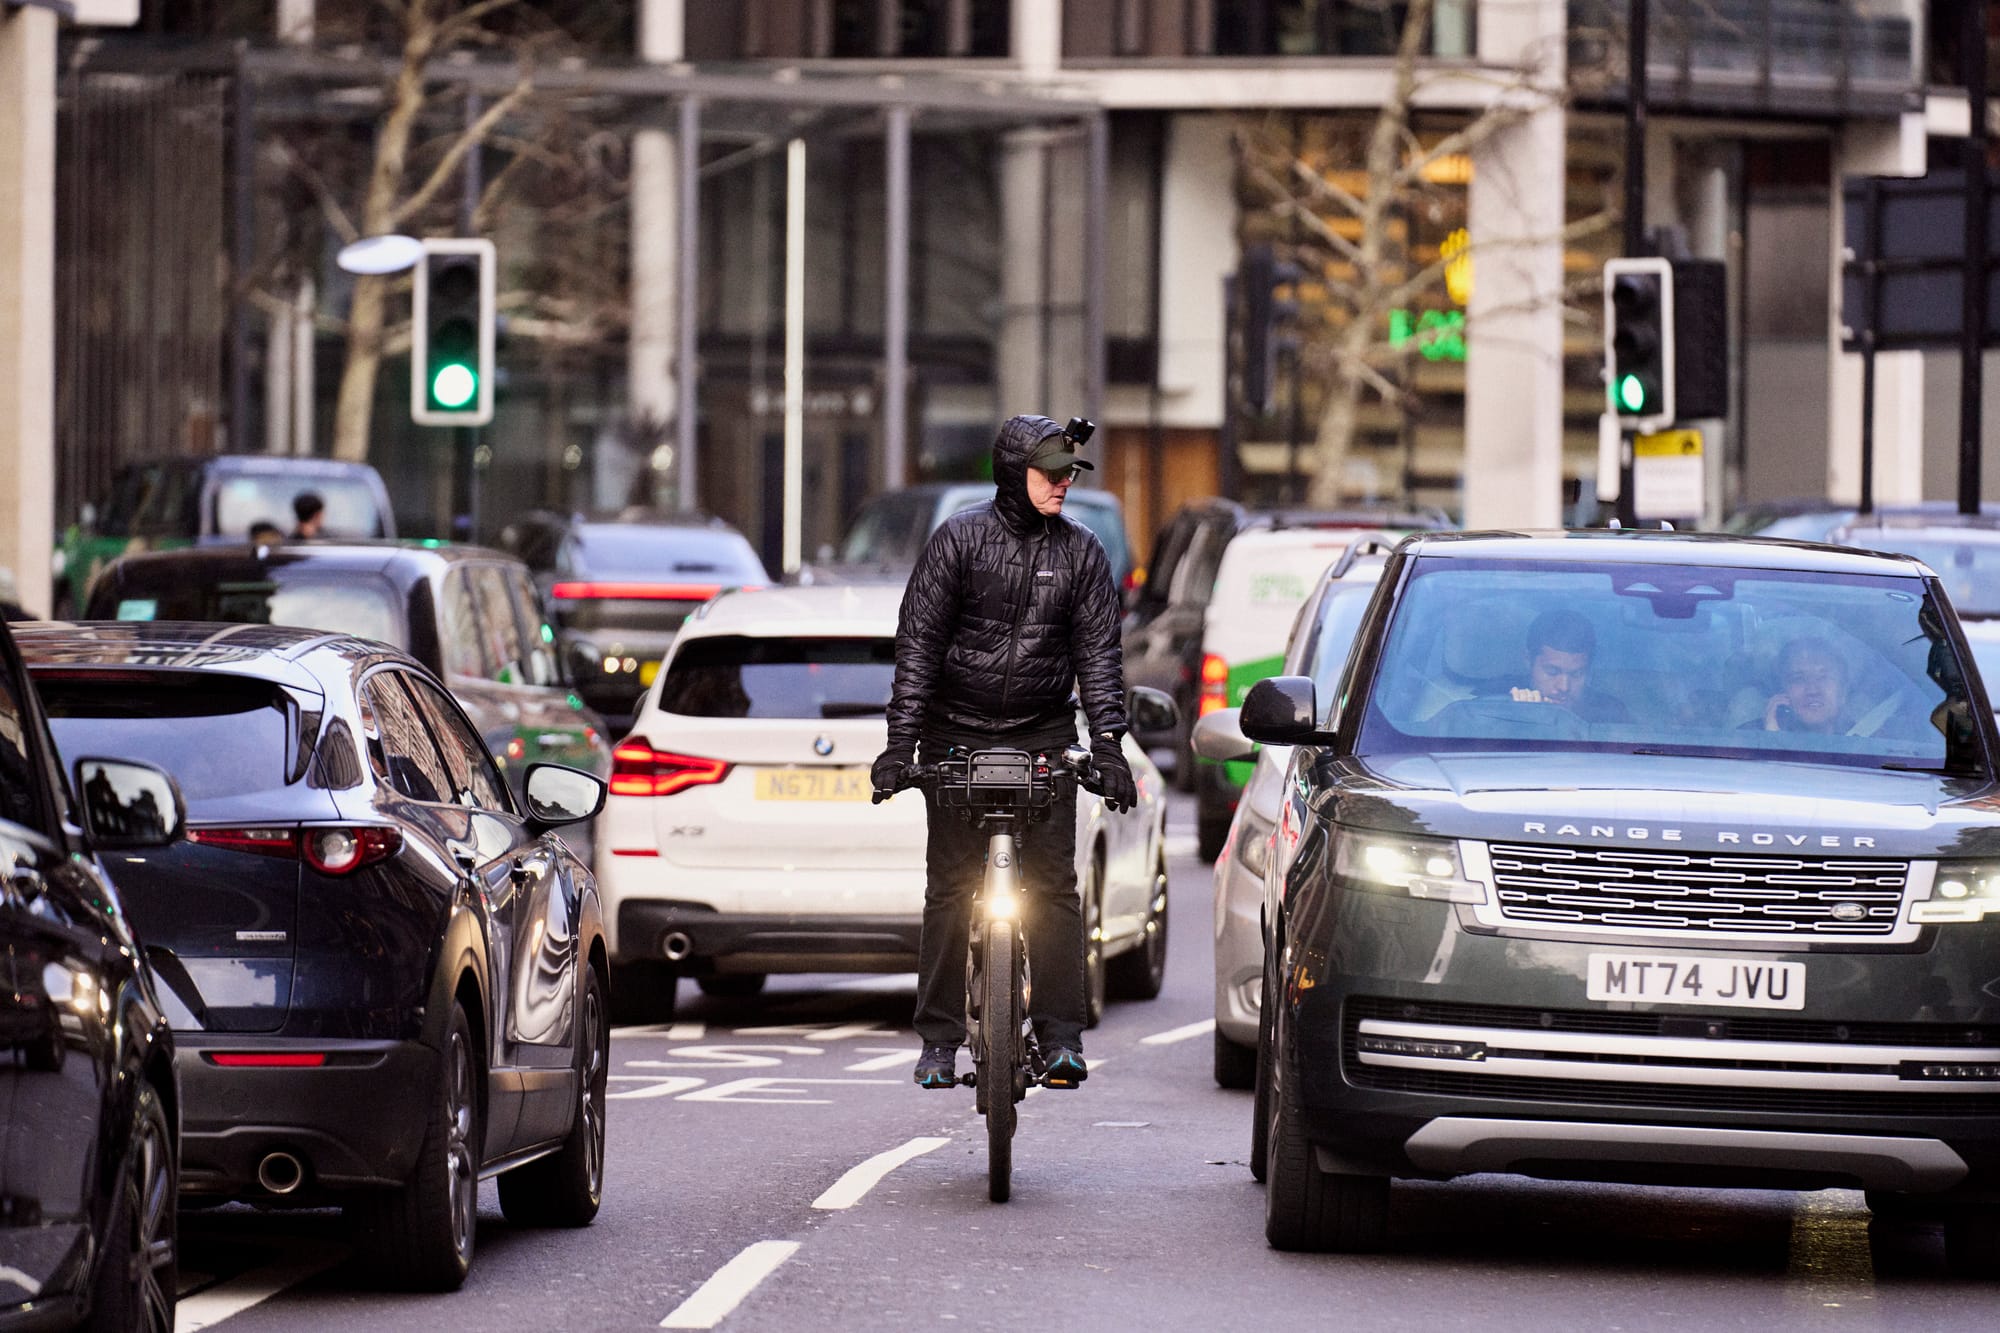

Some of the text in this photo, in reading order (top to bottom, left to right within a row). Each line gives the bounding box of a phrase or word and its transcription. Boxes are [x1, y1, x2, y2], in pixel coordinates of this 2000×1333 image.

[1523, 820, 1876, 849] RANGE ROVER
[1605, 960, 1789, 1001] MT74 JVU
